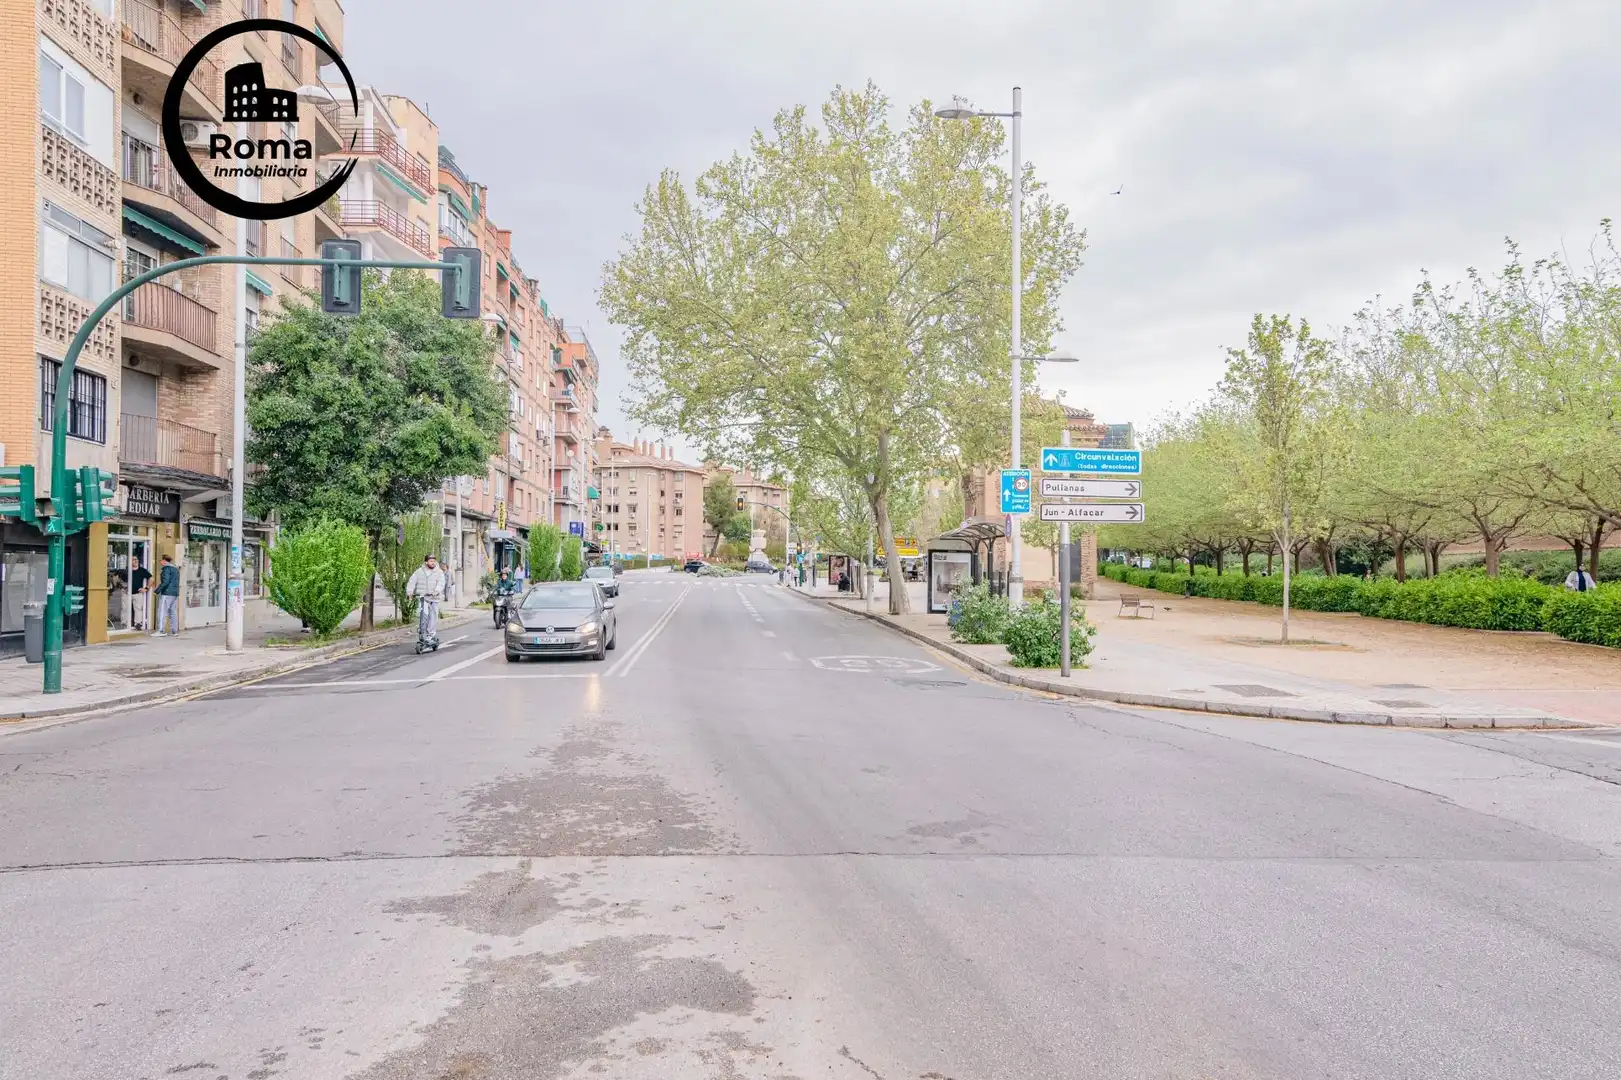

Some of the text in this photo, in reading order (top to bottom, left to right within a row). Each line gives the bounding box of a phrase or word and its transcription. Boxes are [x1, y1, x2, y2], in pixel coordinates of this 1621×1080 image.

[1075, 452, 1137, 462] Circunvalación
[1045, 483, 1085, 492] Pulianas
[128, 501, 161, 516] EDUAR
[1044, 508, 1059, 517] Jun
[1067, 508, 1105, 517] Alfacar
